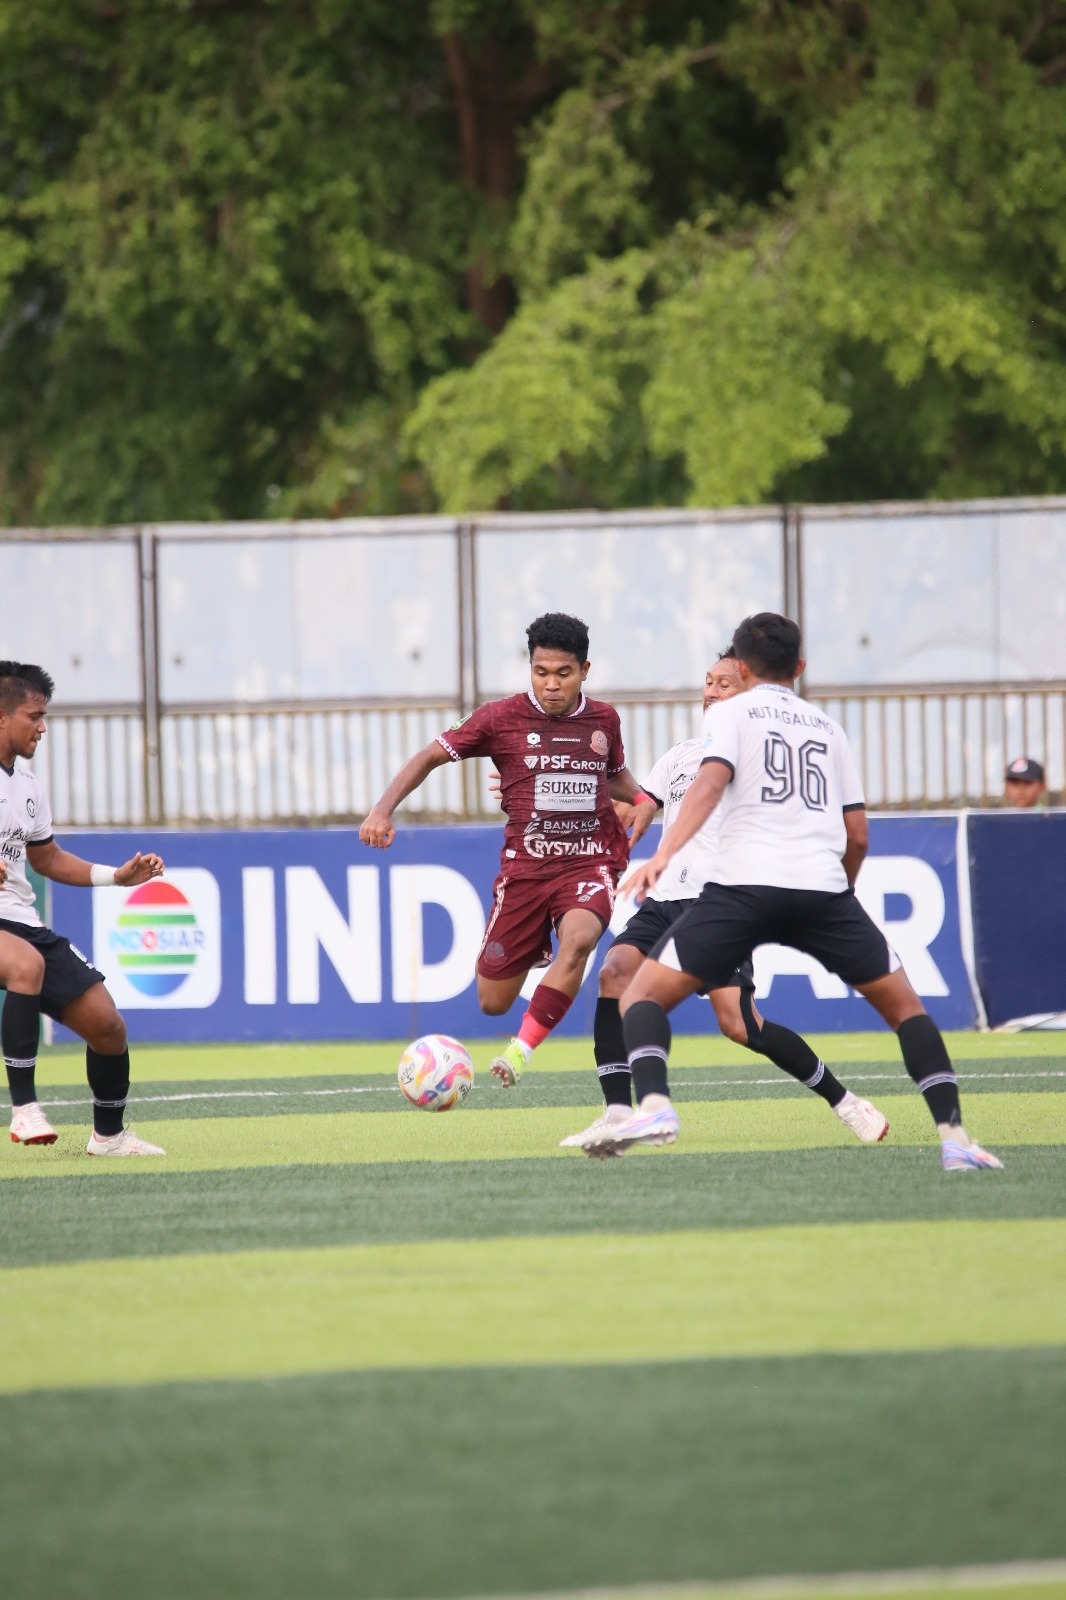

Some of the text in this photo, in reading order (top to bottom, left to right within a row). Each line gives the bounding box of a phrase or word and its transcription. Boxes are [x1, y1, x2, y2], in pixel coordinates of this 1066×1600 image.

[747, 706, 834, 735] HUTAGALUNG
[540, 755, 571, 770] PSF
[760, 731, 828, 812] 96
[541, 781, 594, 795] SUKUN
[543, 820, 579, 830] BANK
[575, 881, 605, 896] 17
[108, 929, 206, 950] INDOSIAR
